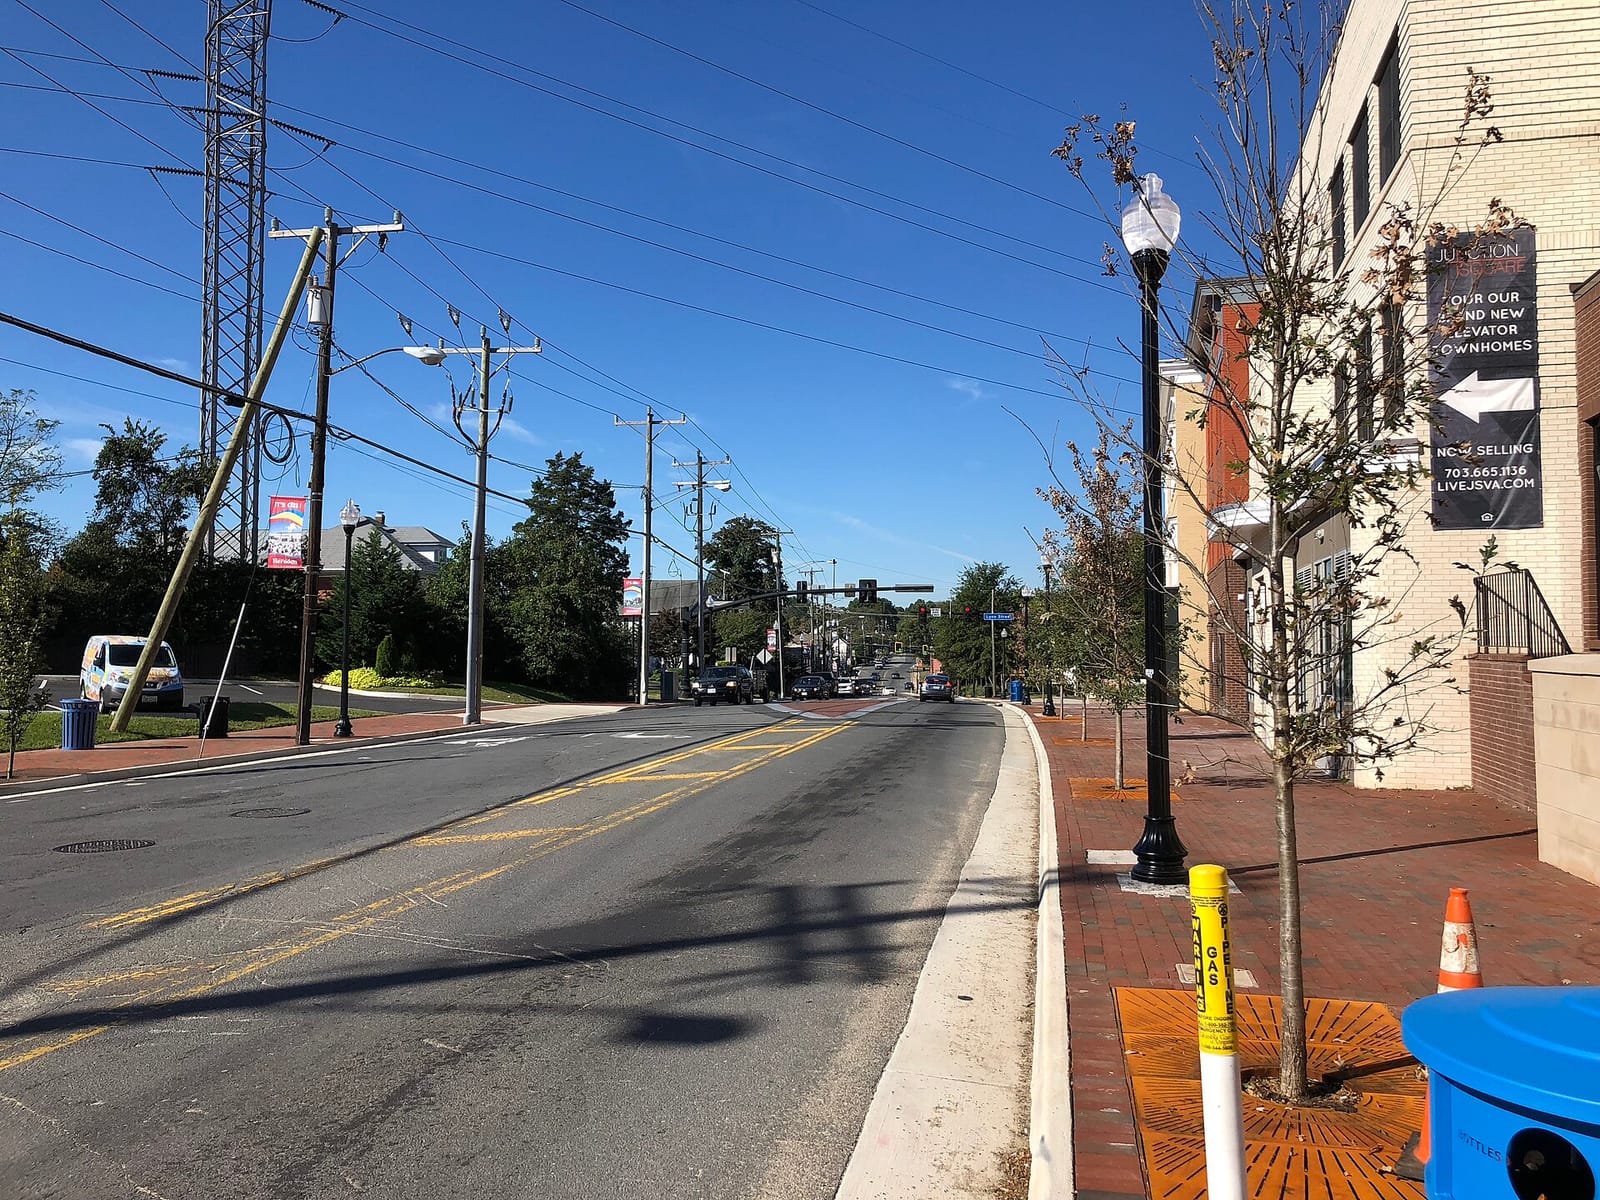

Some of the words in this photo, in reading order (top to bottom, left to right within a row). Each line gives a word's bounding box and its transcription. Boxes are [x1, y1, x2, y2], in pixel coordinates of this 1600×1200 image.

[1436, 244, 1519, 263] JUCTION
[1442, 294, 1483, 305] OUR
[1488, 292, 1520, 304] OUR
[1491, 308, 1525, 320] NEW
[1449, 324, 1518, 339] LEVATOR
[1437, 446, 1472, 457] NOW
[1477, 443, 1533, 455] SELLING
[1444, 465, 1527, 478] 703.665.1136
[1437, 478, 1535, 492] LIVEJSVA.COM
[1191, 917, 1206, 1012] WARNING
[1207, 947, 1219, 986] GAS
[1220, 917, 1234, 1015] PIPELINE
[1458, 1128, 1502, 1162] TTLES
